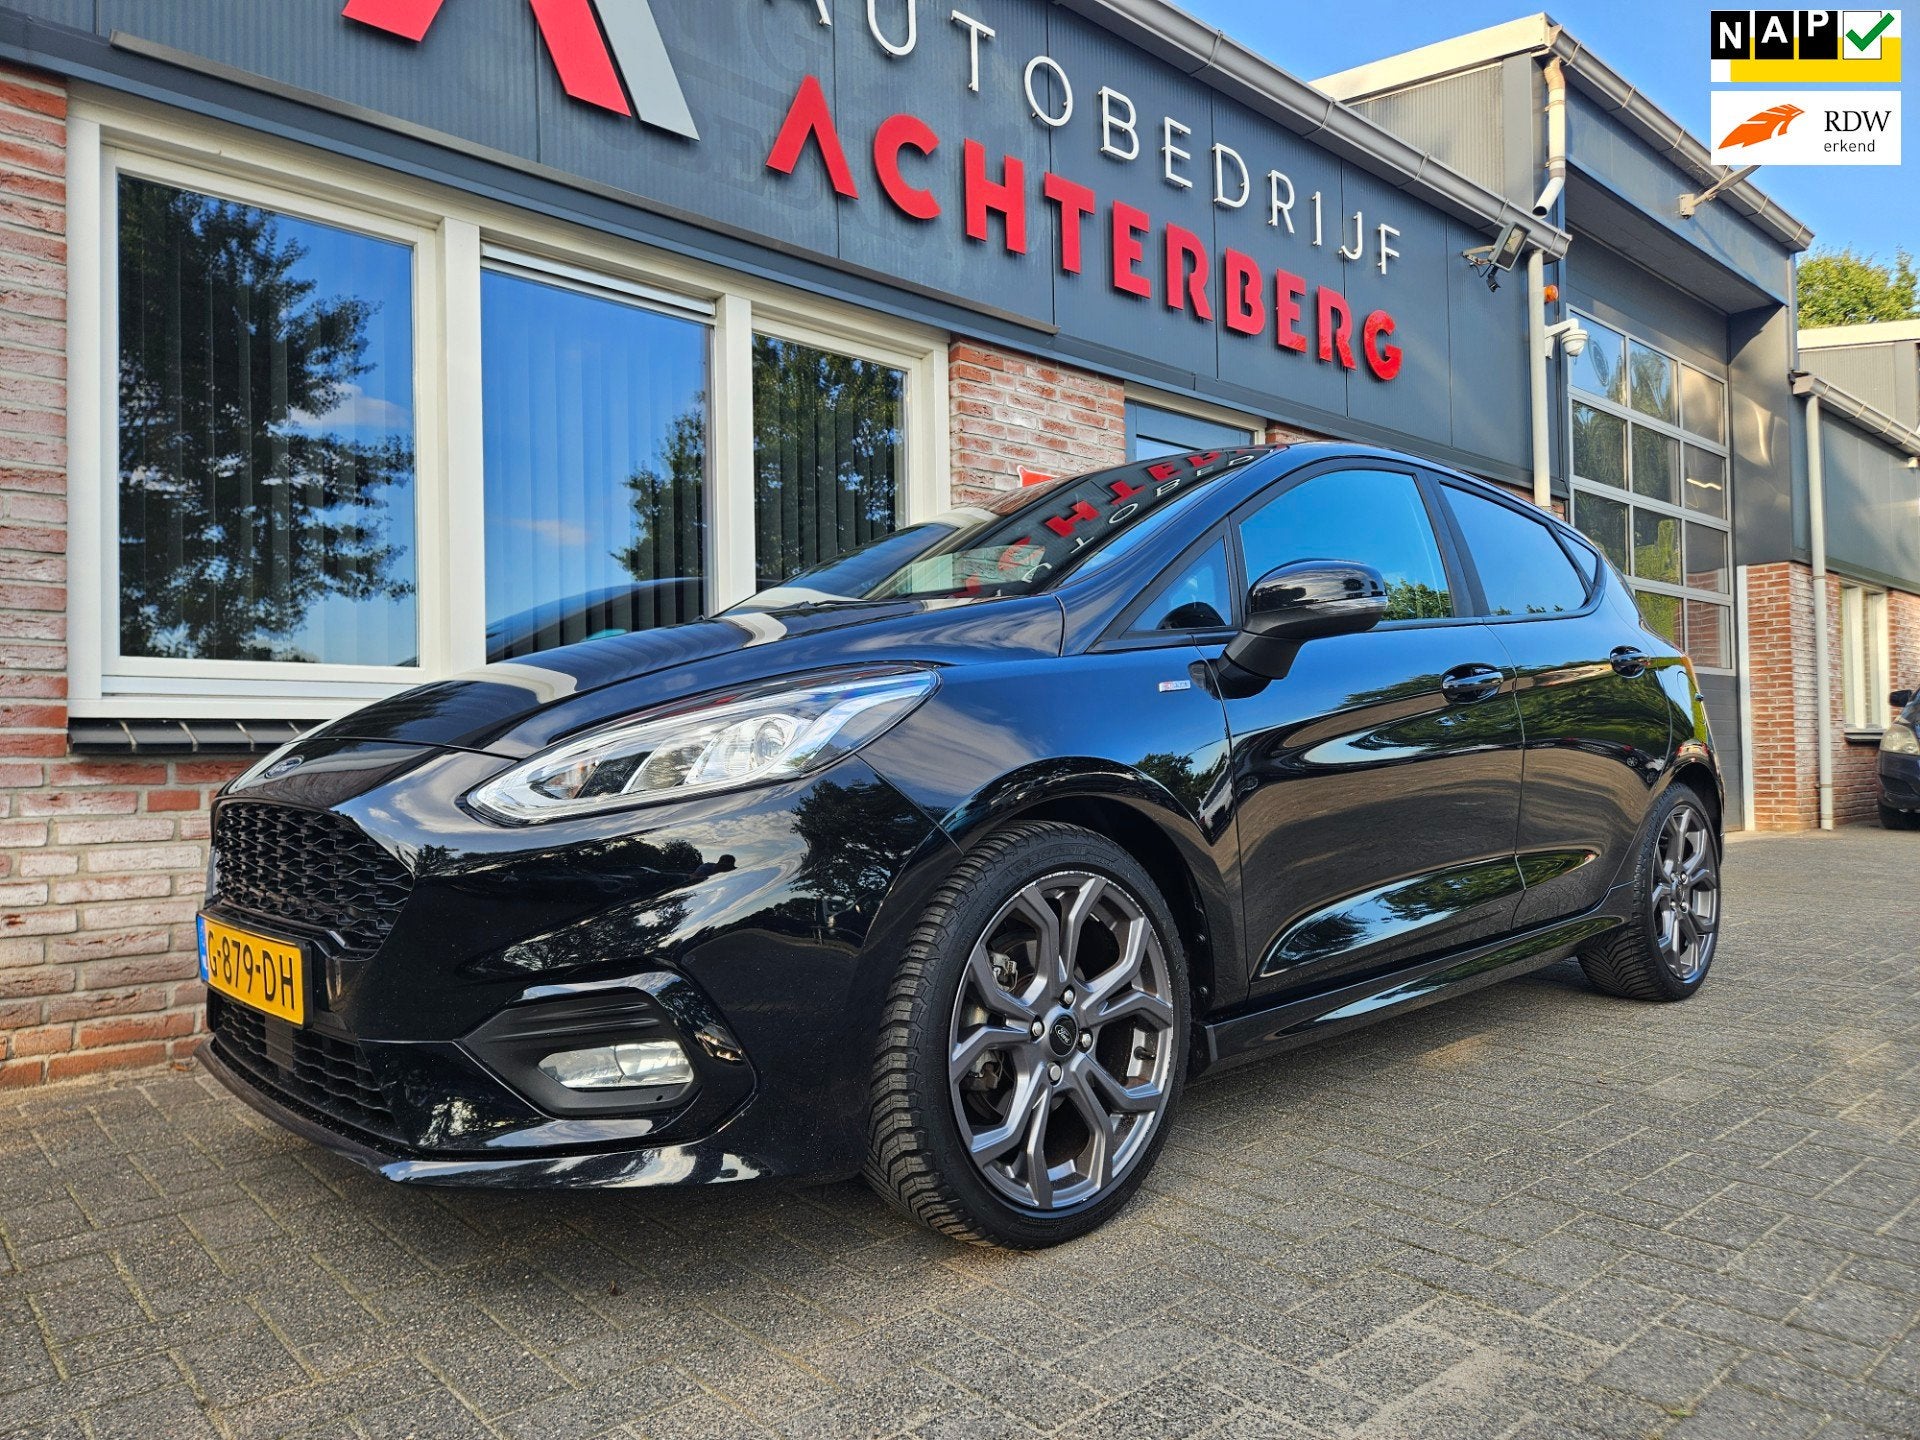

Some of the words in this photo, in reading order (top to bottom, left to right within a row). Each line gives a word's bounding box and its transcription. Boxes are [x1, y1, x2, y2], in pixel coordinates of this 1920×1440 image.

[765, 74, 1402, 381] ACHTERBERG
[815, 0, 1401, 275] UTOBEDRIJF
[208, 930, 295, 1010] G-879-DH
